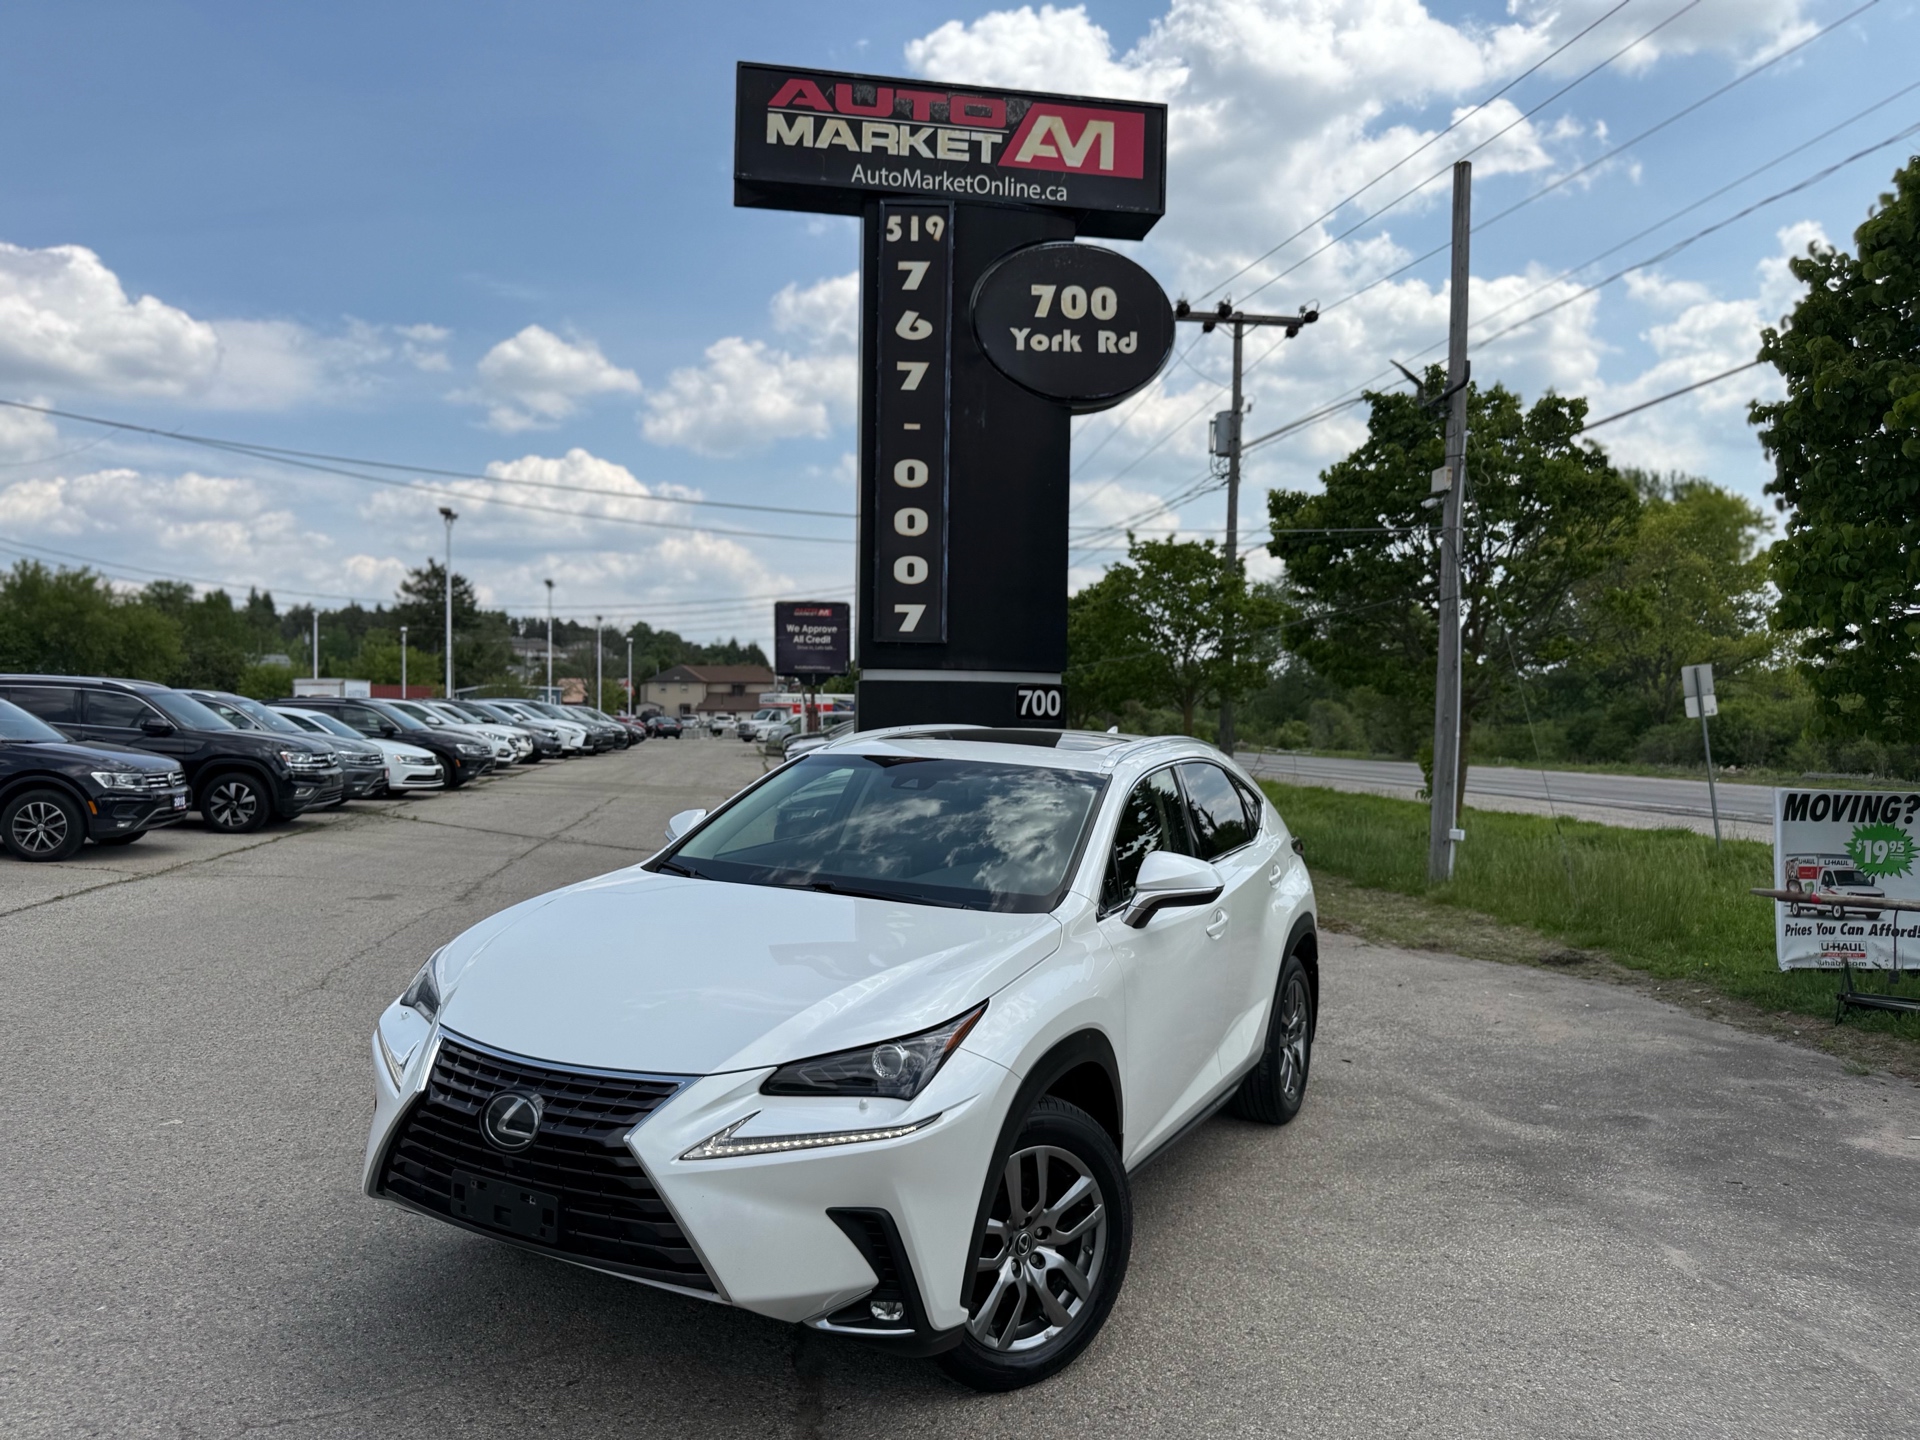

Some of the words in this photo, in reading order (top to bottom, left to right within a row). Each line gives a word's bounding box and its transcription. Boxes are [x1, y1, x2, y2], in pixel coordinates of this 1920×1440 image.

[767, 78, 1007, 128] AUTO
[766, 112, 1003, 164] MARKET
[851, 163, 1068, 202] AutoMarketOnline.ca
[886, 214, 945, 243] 519
[1031, 284, 1118, 320] 700
[1009, 327, 1082, 352] York
[1098, 329, 1138, 354] Rd
[786, 624, 800, 633] We
[802, 624, 838, 635] Approve
[793, 635, 805, 643] All
[805, 635, 831, 644] Credit
[1018, 689, 1061, 717] 700
[1783, 793, 1920, 825] MOVING?
[1824, 859, 1850, 867] U-HAUL
[1785, 923, 1812, 937] Prices
[1816, 922, 1836, 936] You
[1840, 922, 1864, 936] Can
[1820, 942, 1865, 952] U-HAUL
